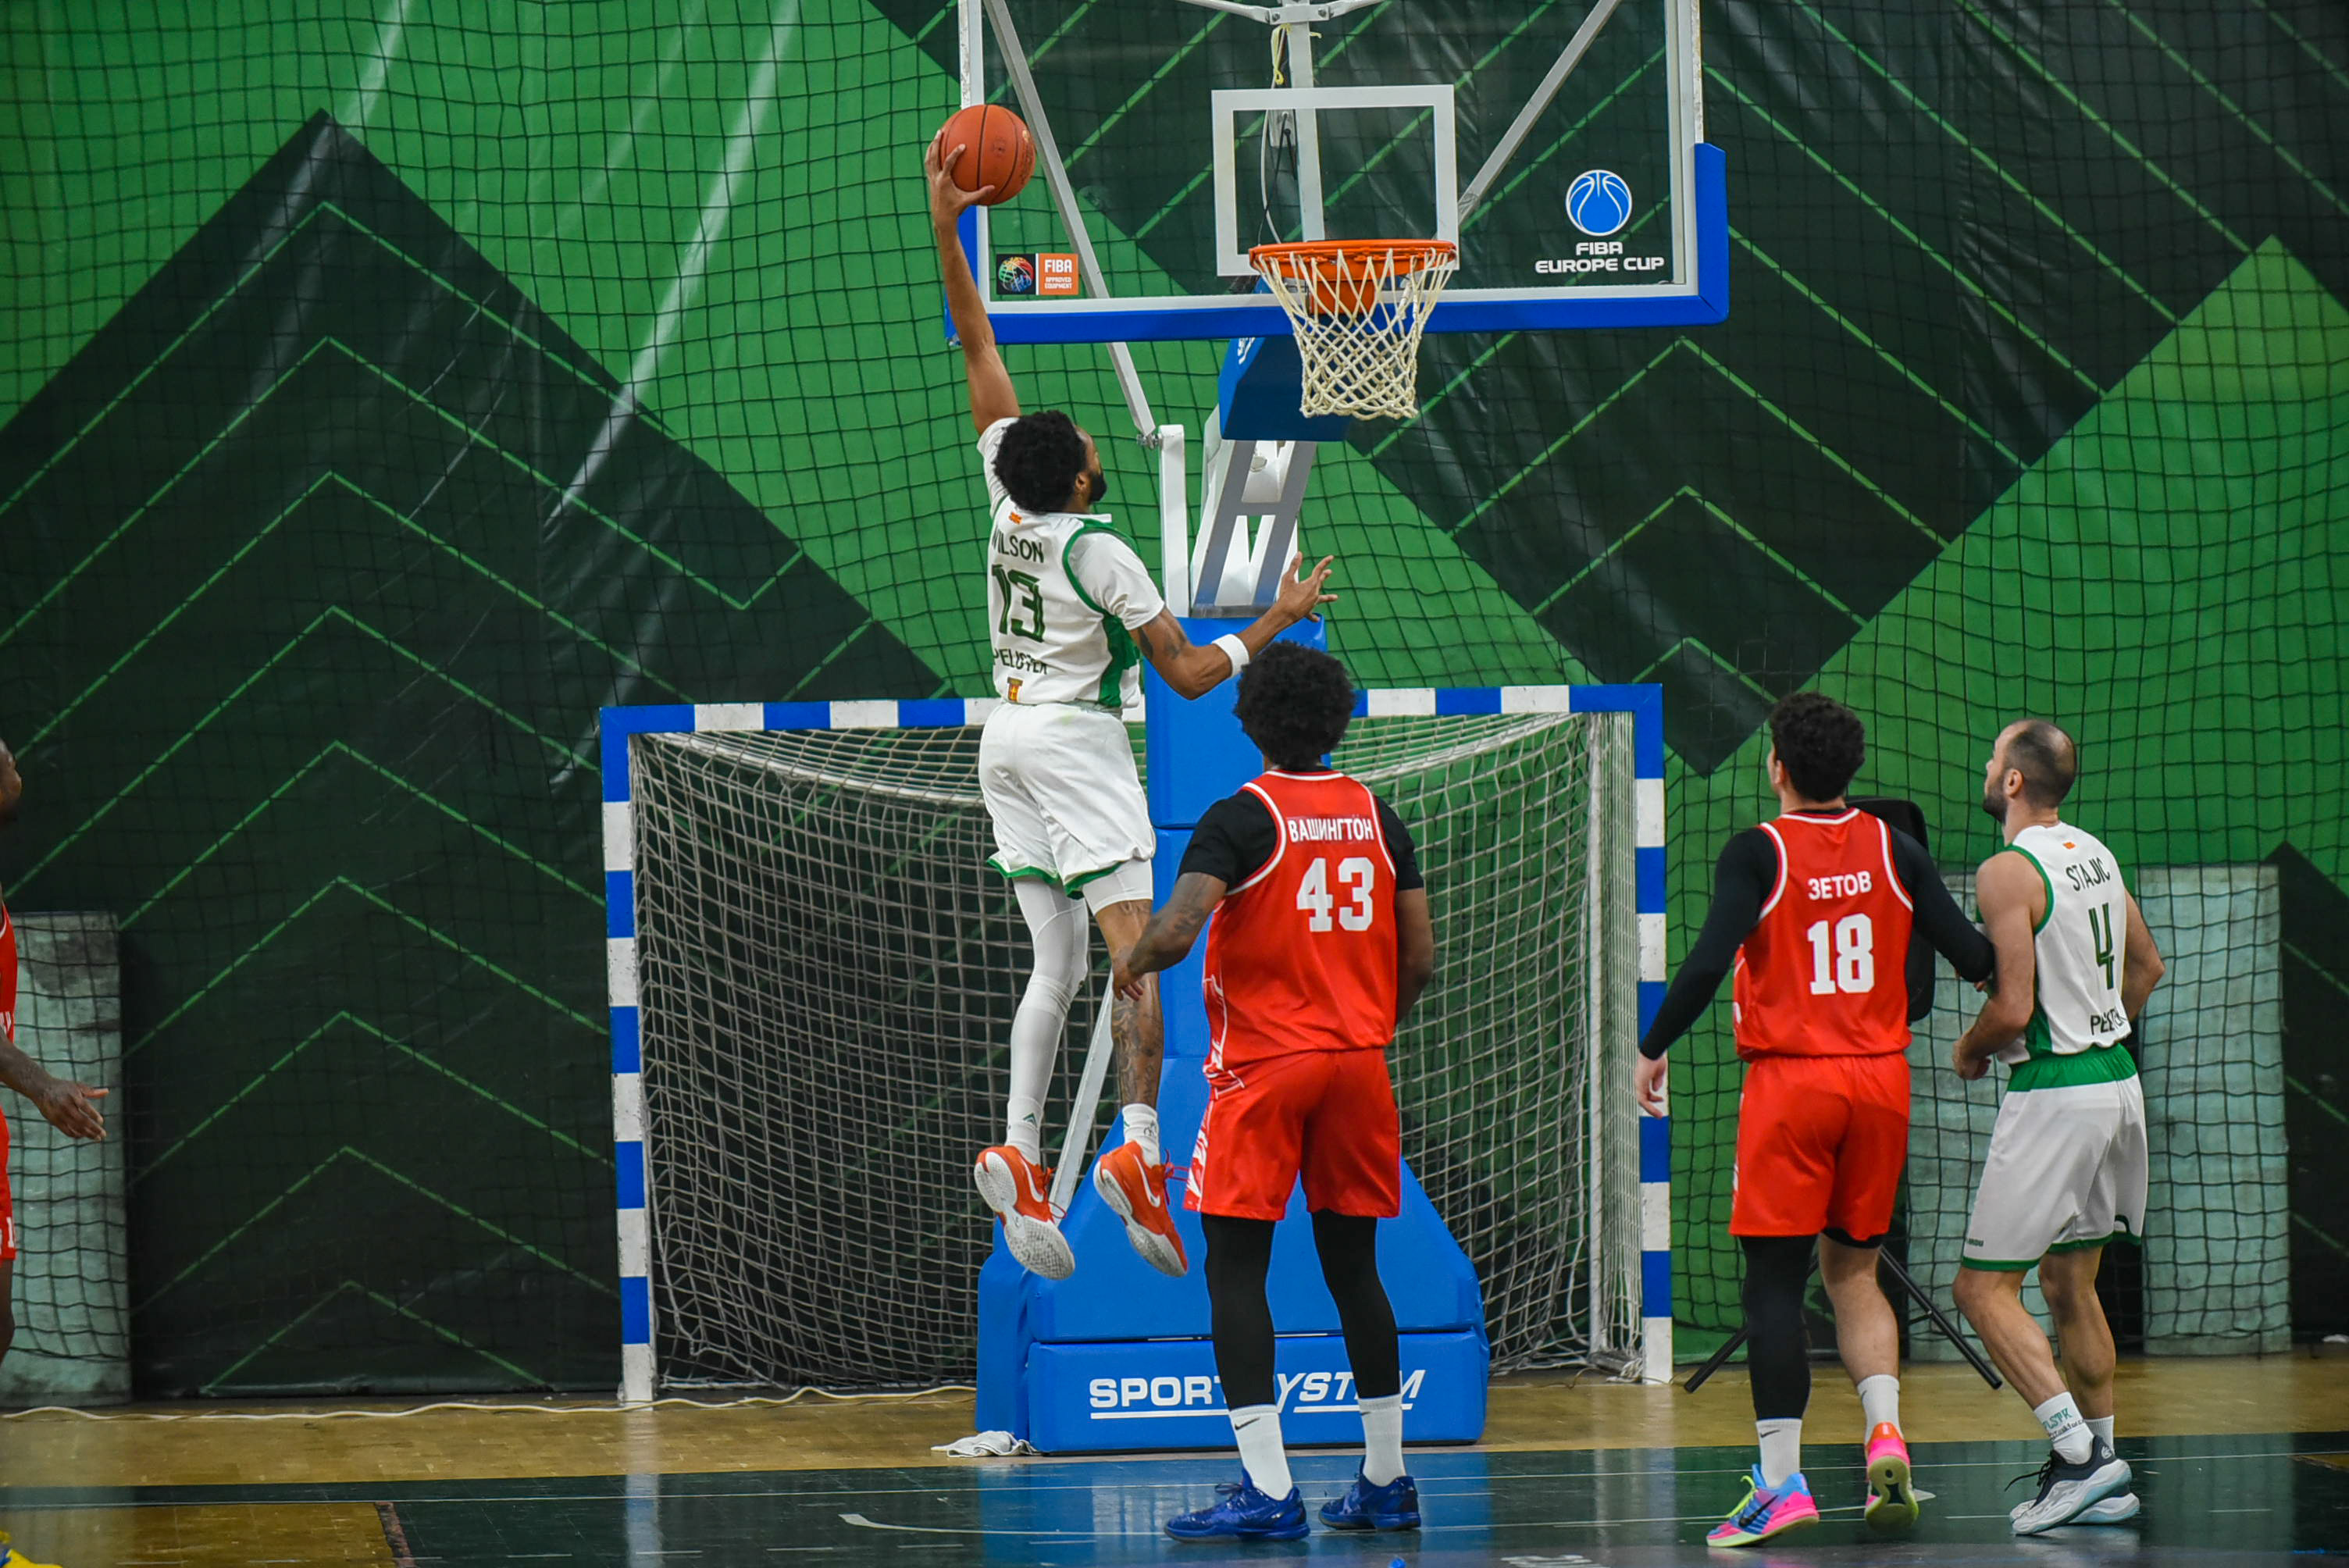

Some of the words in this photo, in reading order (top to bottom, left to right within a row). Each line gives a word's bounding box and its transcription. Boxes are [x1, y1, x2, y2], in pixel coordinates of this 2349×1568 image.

[1576, 241, 1623, 255] FIBA
[1045, 259, 1072, 273] FIBA
[1535, 258, 1618, 273] EUROPE
[1624, 257, 1664, 270] CUP
[992, 564, 1045, 643] 13
[1288, 818, 1374, 843] ВАШИНГТОН
[1808, 871, 1872, 900] ЗЕТОВ
[2066, 857, 2111, 892] STAJIC
[1296, 857, 1374, 932] 43
[1807, 913, 1875, 995] 18
[2088, 902, 2115, 990] 4
